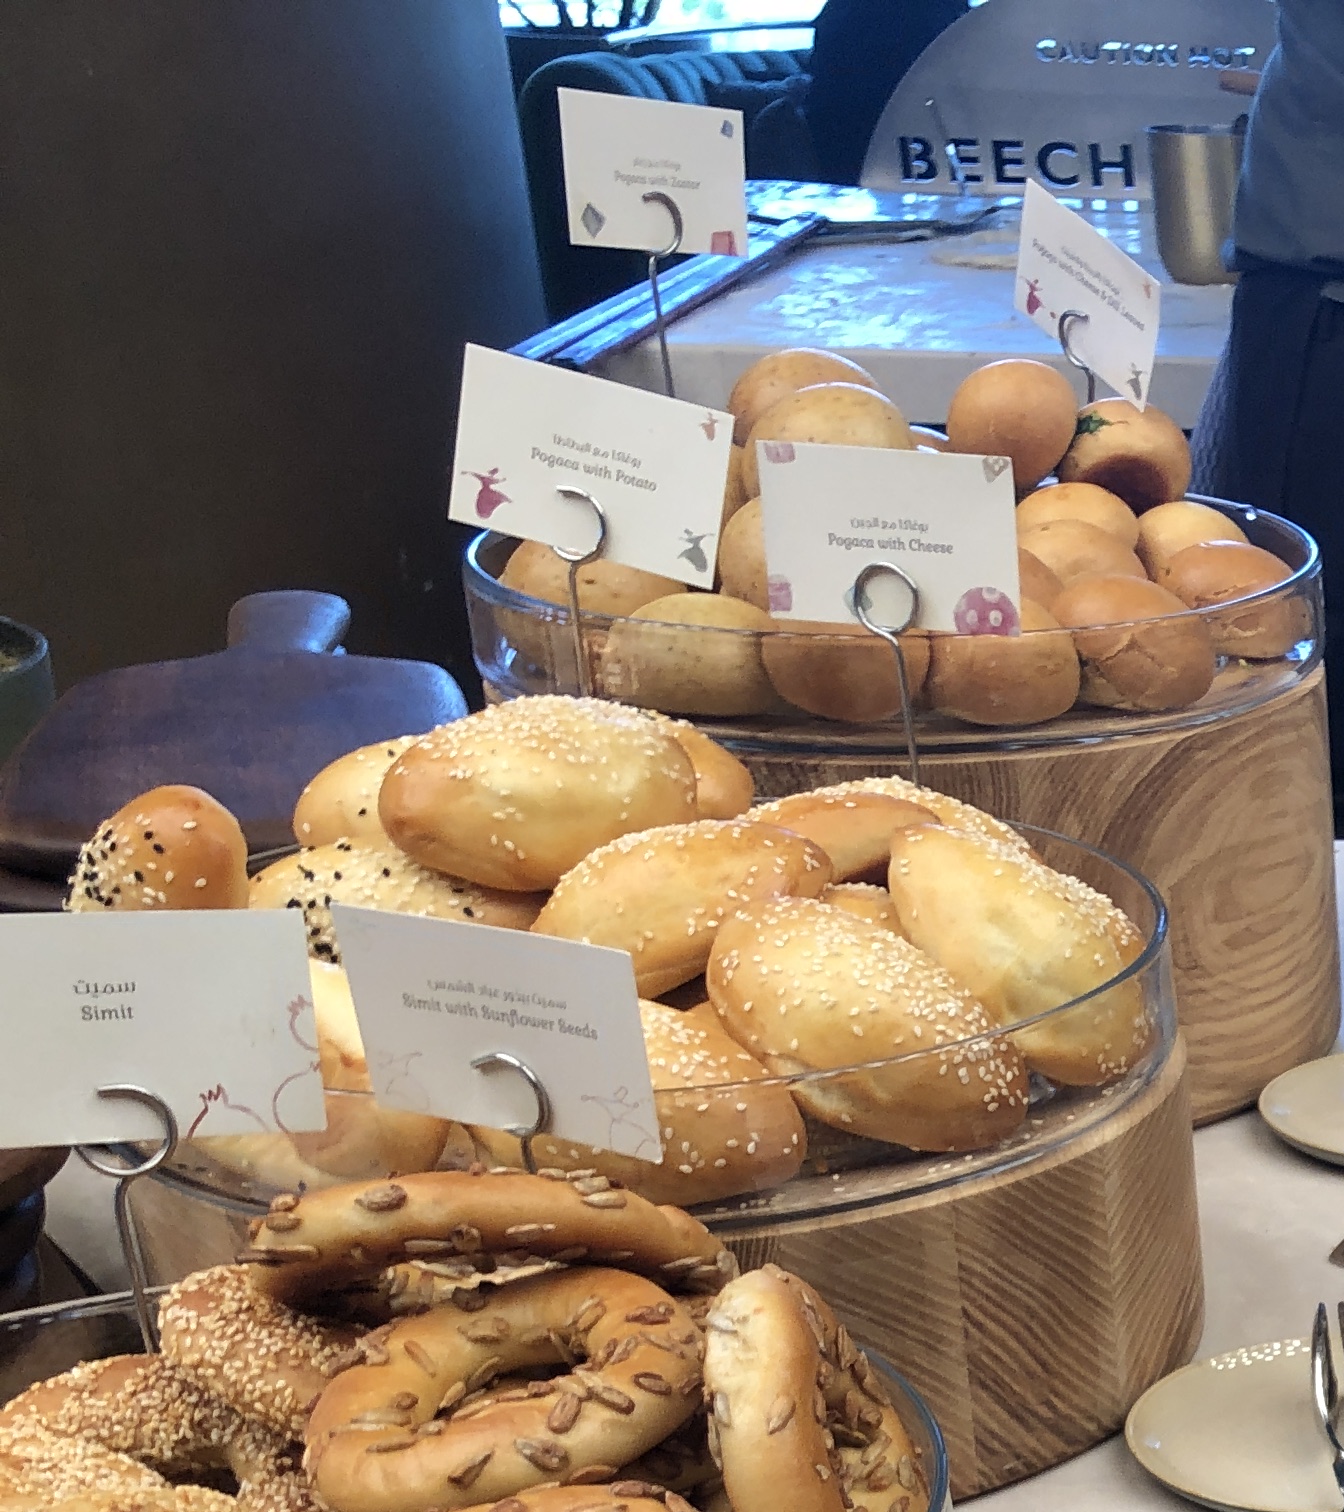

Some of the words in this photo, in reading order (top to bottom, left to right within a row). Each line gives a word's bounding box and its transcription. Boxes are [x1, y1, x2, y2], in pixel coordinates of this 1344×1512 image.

[1035, 37, 1179, 67] CAUTION
[1187, 46, 1256, 69] HOT
[899, 135, 1136, 189] BEECH
[531, 446, 580, 468] Pogaca
[582, 463, 612, 480] with
[615, 468, 658, 492] Potato
[828, 532, 875, 550] Pogaca
[877, 537, 906, 551] with
[908, 538, 954, 554] Cheese
[73, 979, 136, 998] سميت
[81, 1004, 134, 1021] Simit
[401, 991, 442, 1013] Simit
[445, 1000, 479, 1019] with
[480, 1003, 555, 1031] Sunflower
[557, 1017, 599, 1040] Seeds
